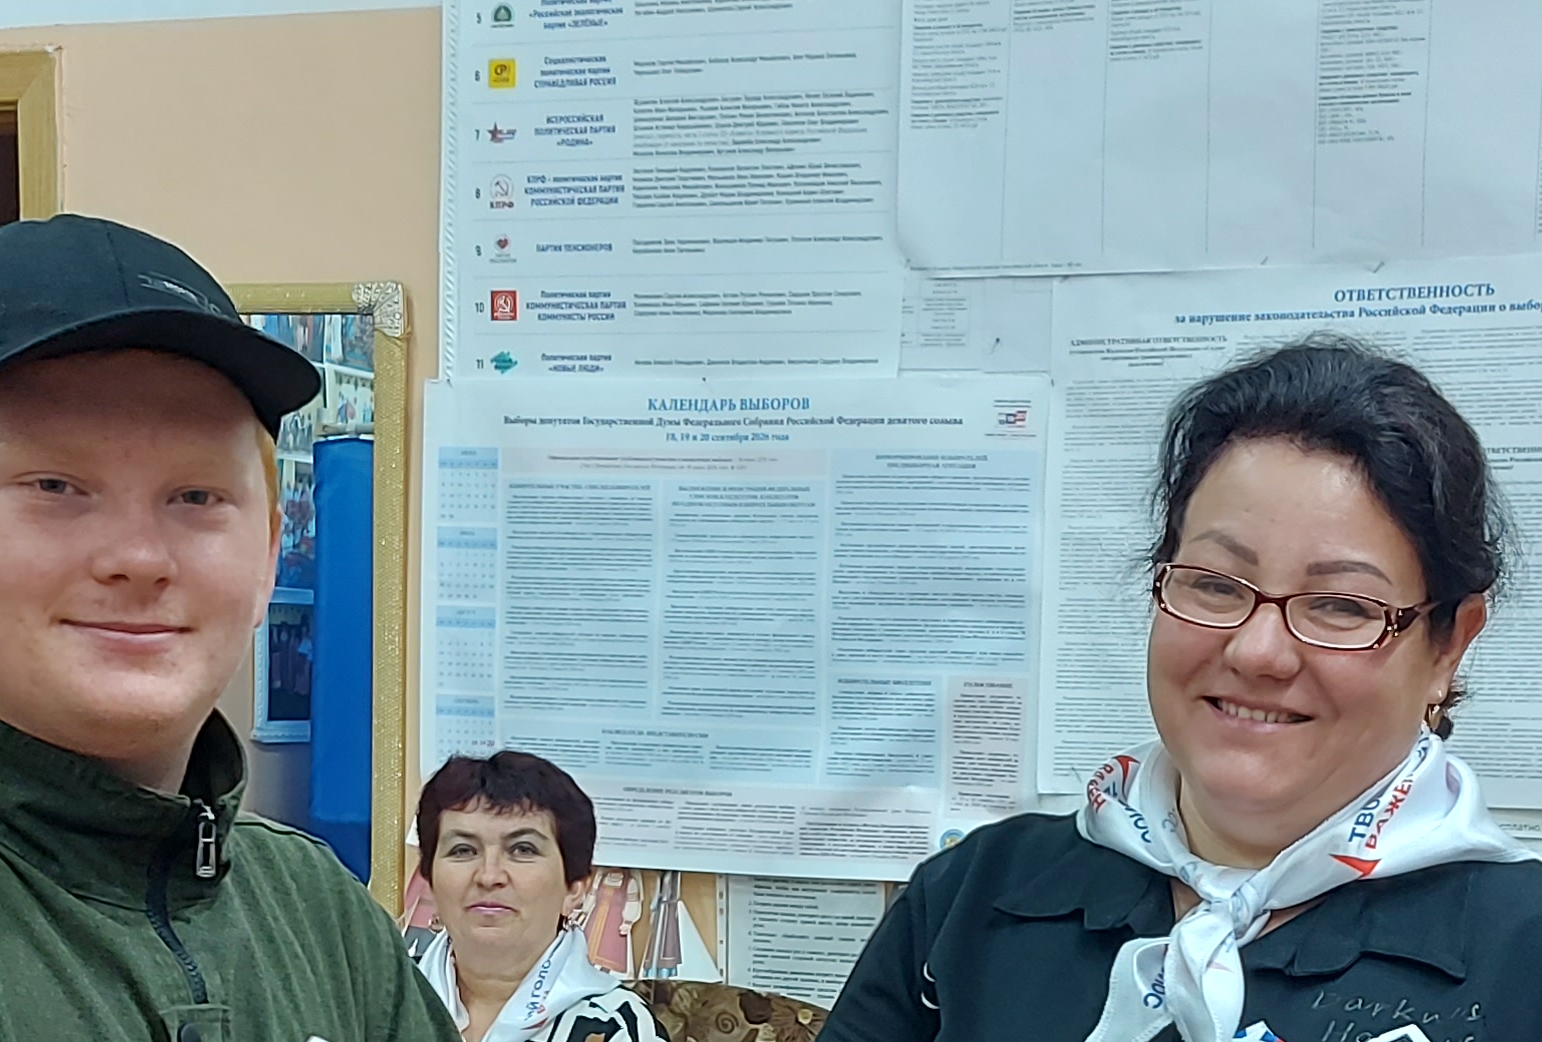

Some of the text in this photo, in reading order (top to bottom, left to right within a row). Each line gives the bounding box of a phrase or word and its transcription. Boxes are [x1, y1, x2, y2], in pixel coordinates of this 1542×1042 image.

[1334, 283, 1495, 303] ОТВЕТСТВЕННОСТЬ
[475, 302, 485, 314] 10
[1175, 315, 1186, 324] за
[1188, 313, 1251, 326] нарушение
[1253, 308, 1355, 322] законодательства
[1358, 303, 1427, 319] Российской
[1429, 302, 1496, 318] Федерации
[476, 358, 484, 370] 11
[647, 397, 810, 413] КАЛЕНДАРЬ ВЫБОРОВ
[504, 415, 537, 426] Выборы
[583, 416, 654, 428] Государственной
[656, 417, 681, 427] Думы
[683, 418, 742, 428] Федерального
[743, 416, 784, 427] Собрания
[786, 416, 834, 426] Российской
[836, 415, 885, 426] Федерации
[680, 433, 690, 441] 19
[700, 433, 709, 442] 20
